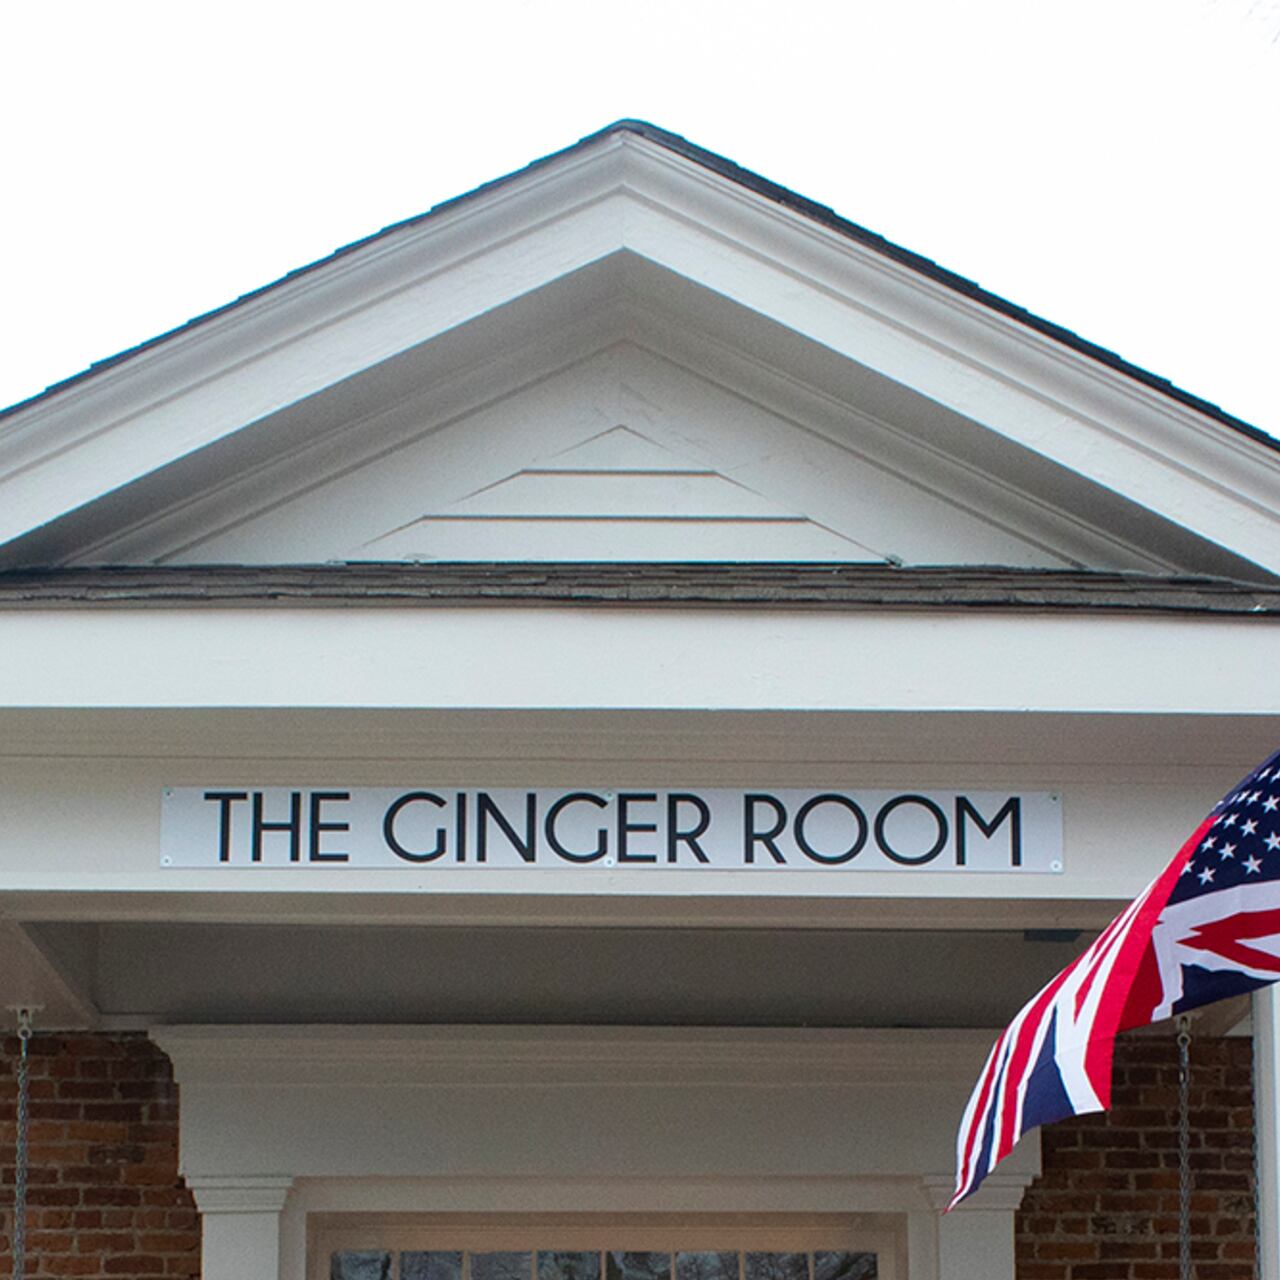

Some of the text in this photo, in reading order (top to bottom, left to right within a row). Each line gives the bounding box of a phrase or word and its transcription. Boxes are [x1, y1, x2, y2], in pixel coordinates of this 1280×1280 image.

[204, 792, 1023, 867] THE GINGER ROOM
